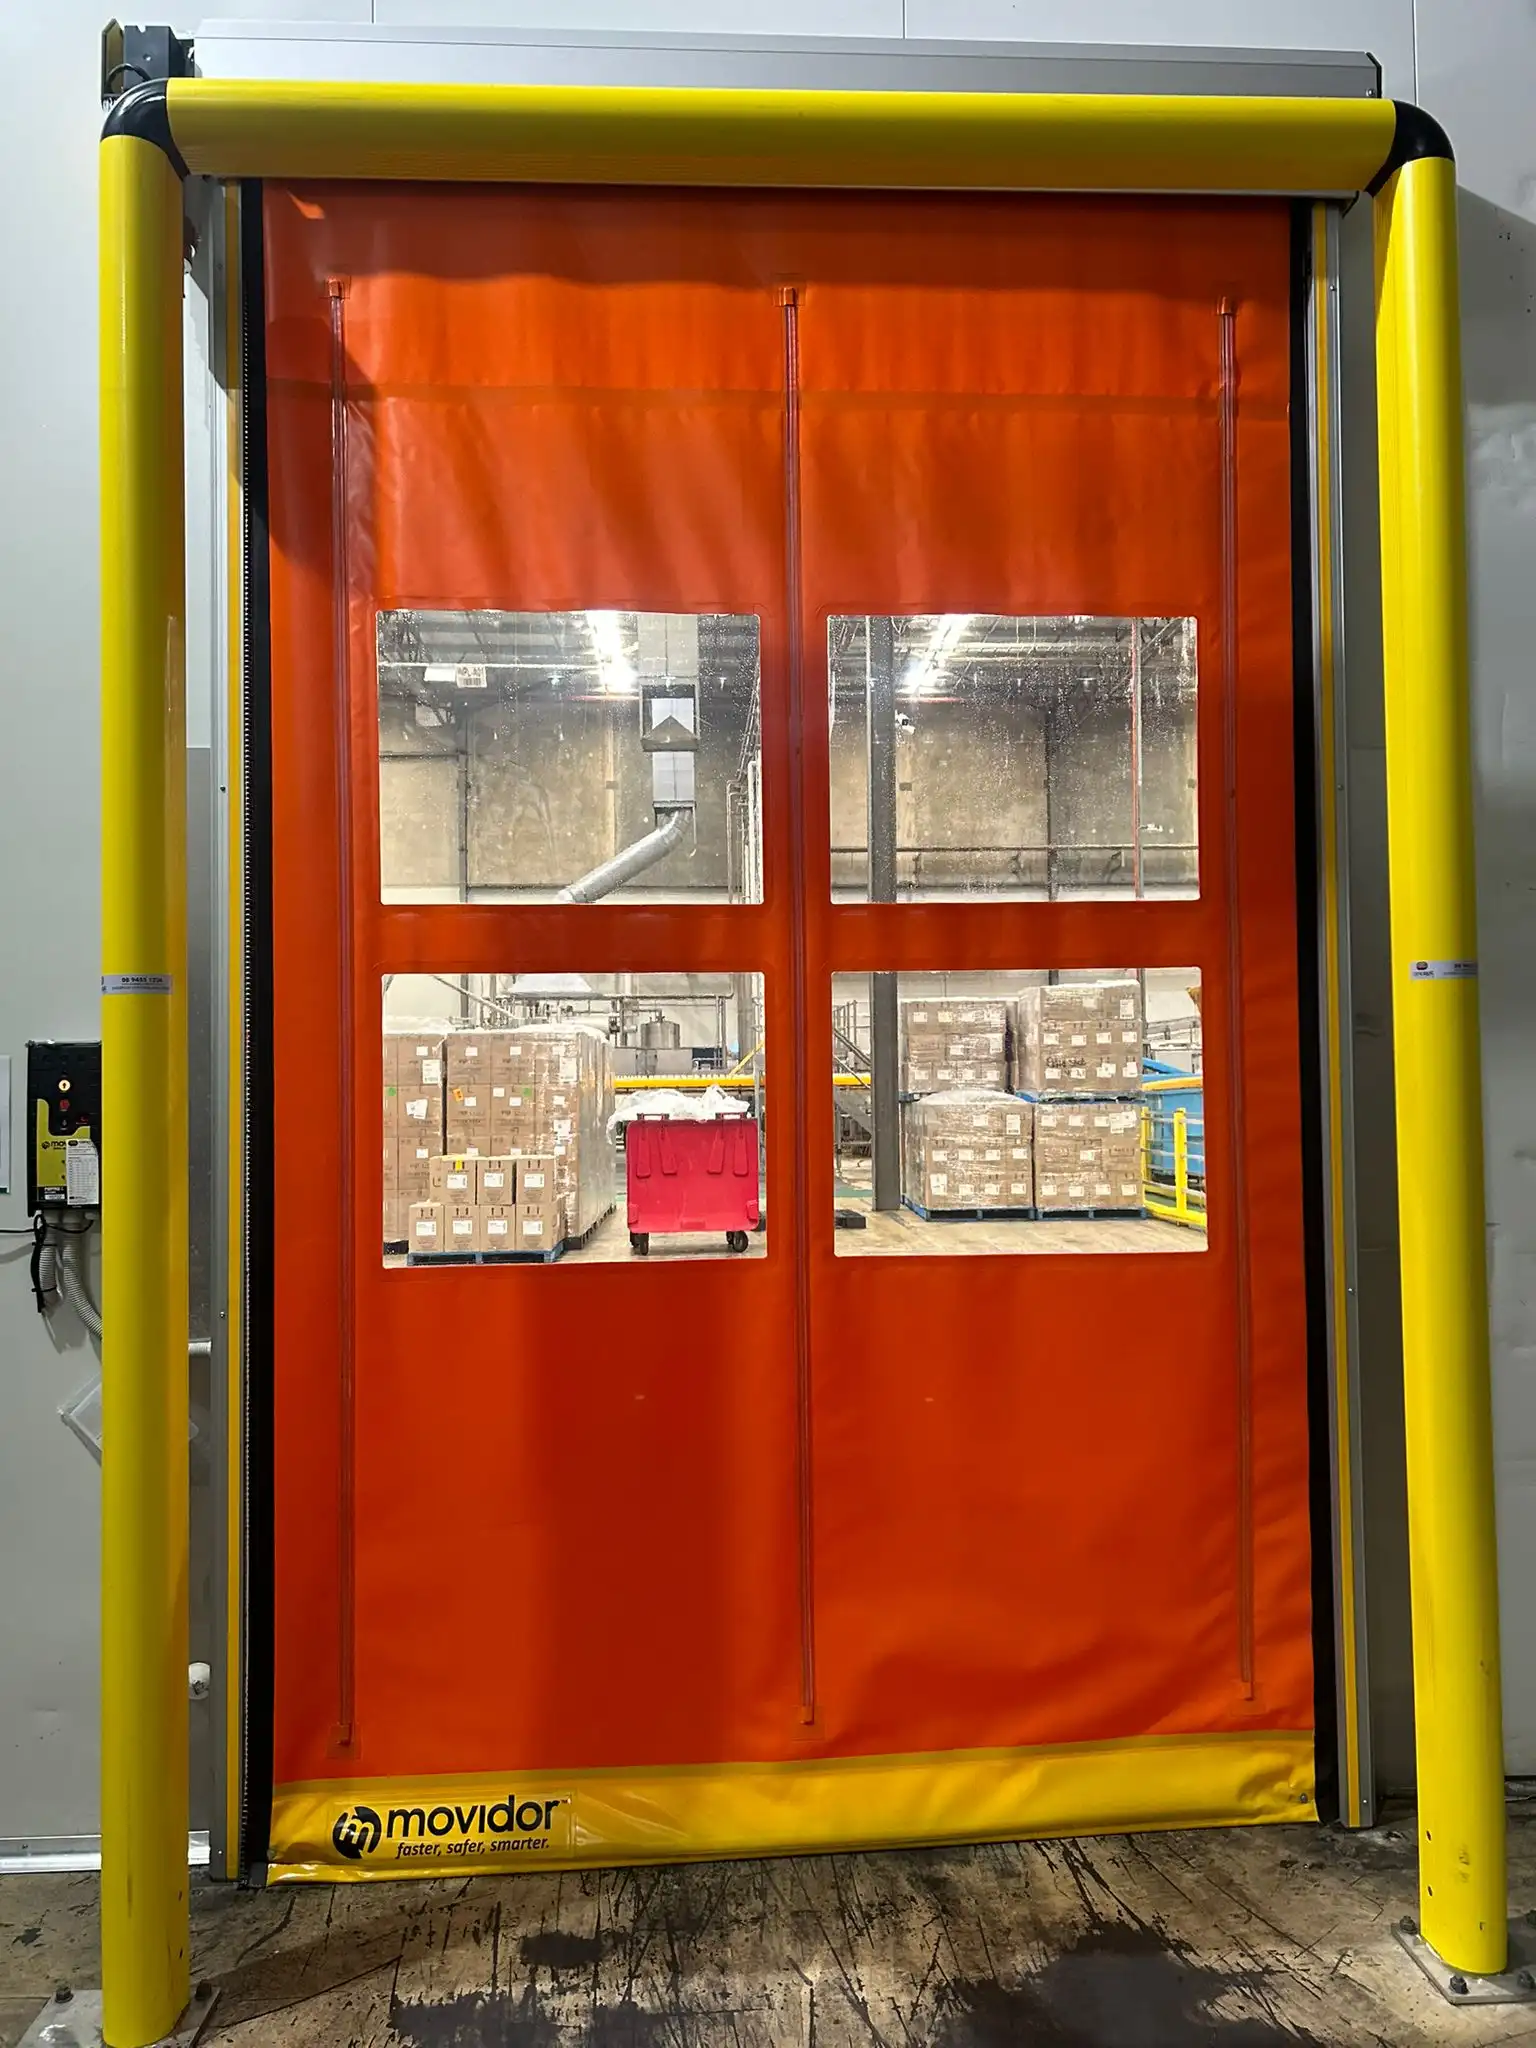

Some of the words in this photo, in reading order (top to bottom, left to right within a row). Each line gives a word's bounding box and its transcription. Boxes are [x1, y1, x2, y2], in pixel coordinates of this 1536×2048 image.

[387, 1795, 561, 1838] movidor
[395, 1841, 442, 1860] faster,
[446, 1839, 486, 1857] safer,
[489, 1836, 550, 1852] smarter.
